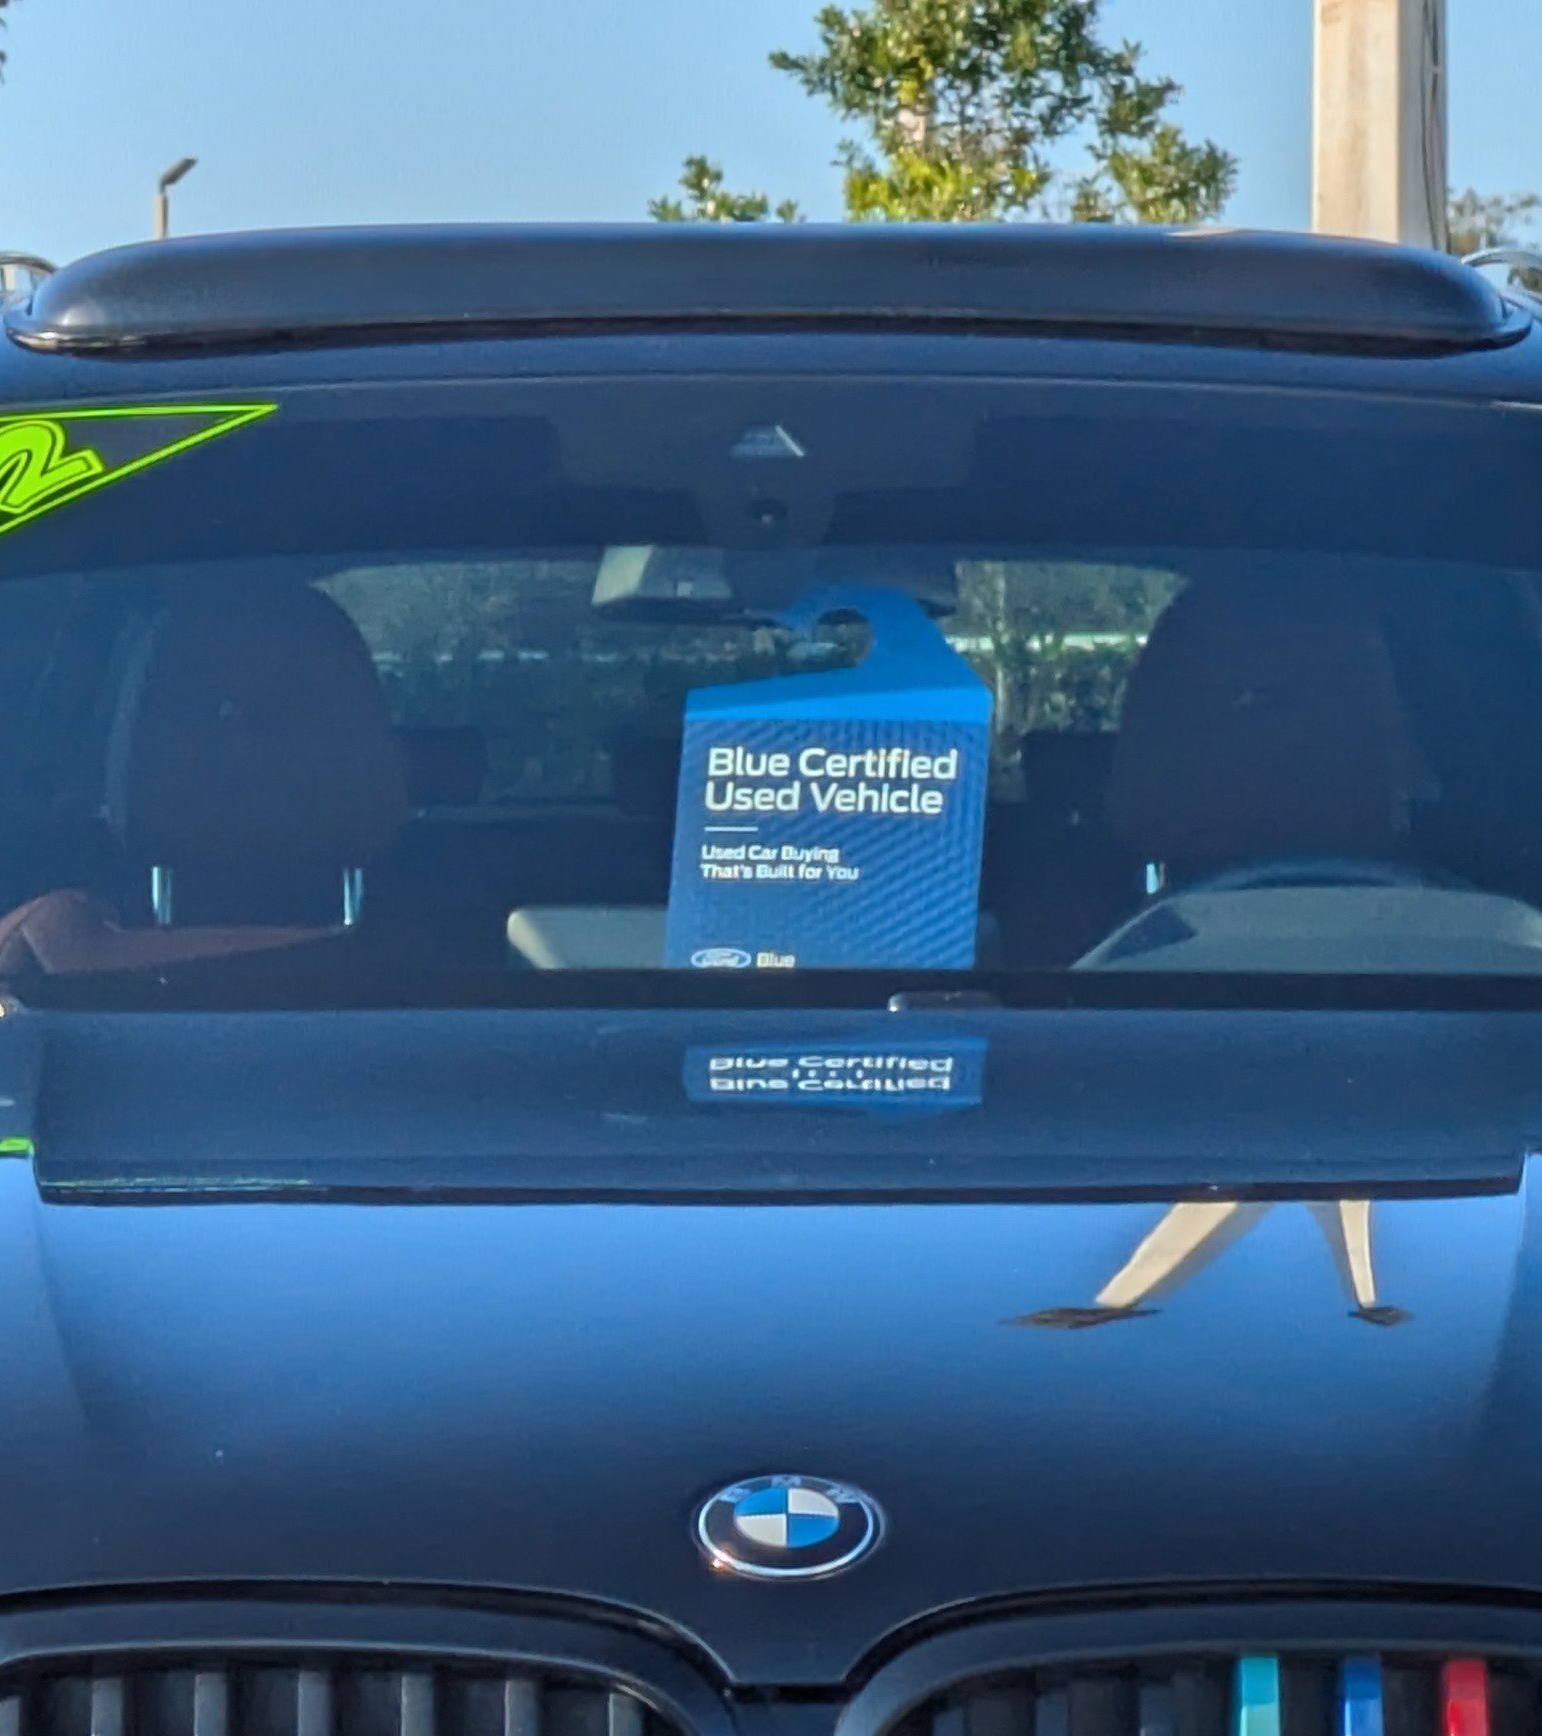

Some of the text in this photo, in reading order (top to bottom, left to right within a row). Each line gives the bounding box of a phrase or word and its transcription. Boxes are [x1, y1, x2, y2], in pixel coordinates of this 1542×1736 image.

[707, 746, 958, 780] Blue Certified
[704, 780, 944, 814] Used Vehicle
[701, 845, 840, 863] Used Car Buying
[700, 863, 859, 880] That's Built for You
[756, 951, 796, 968] Blue
